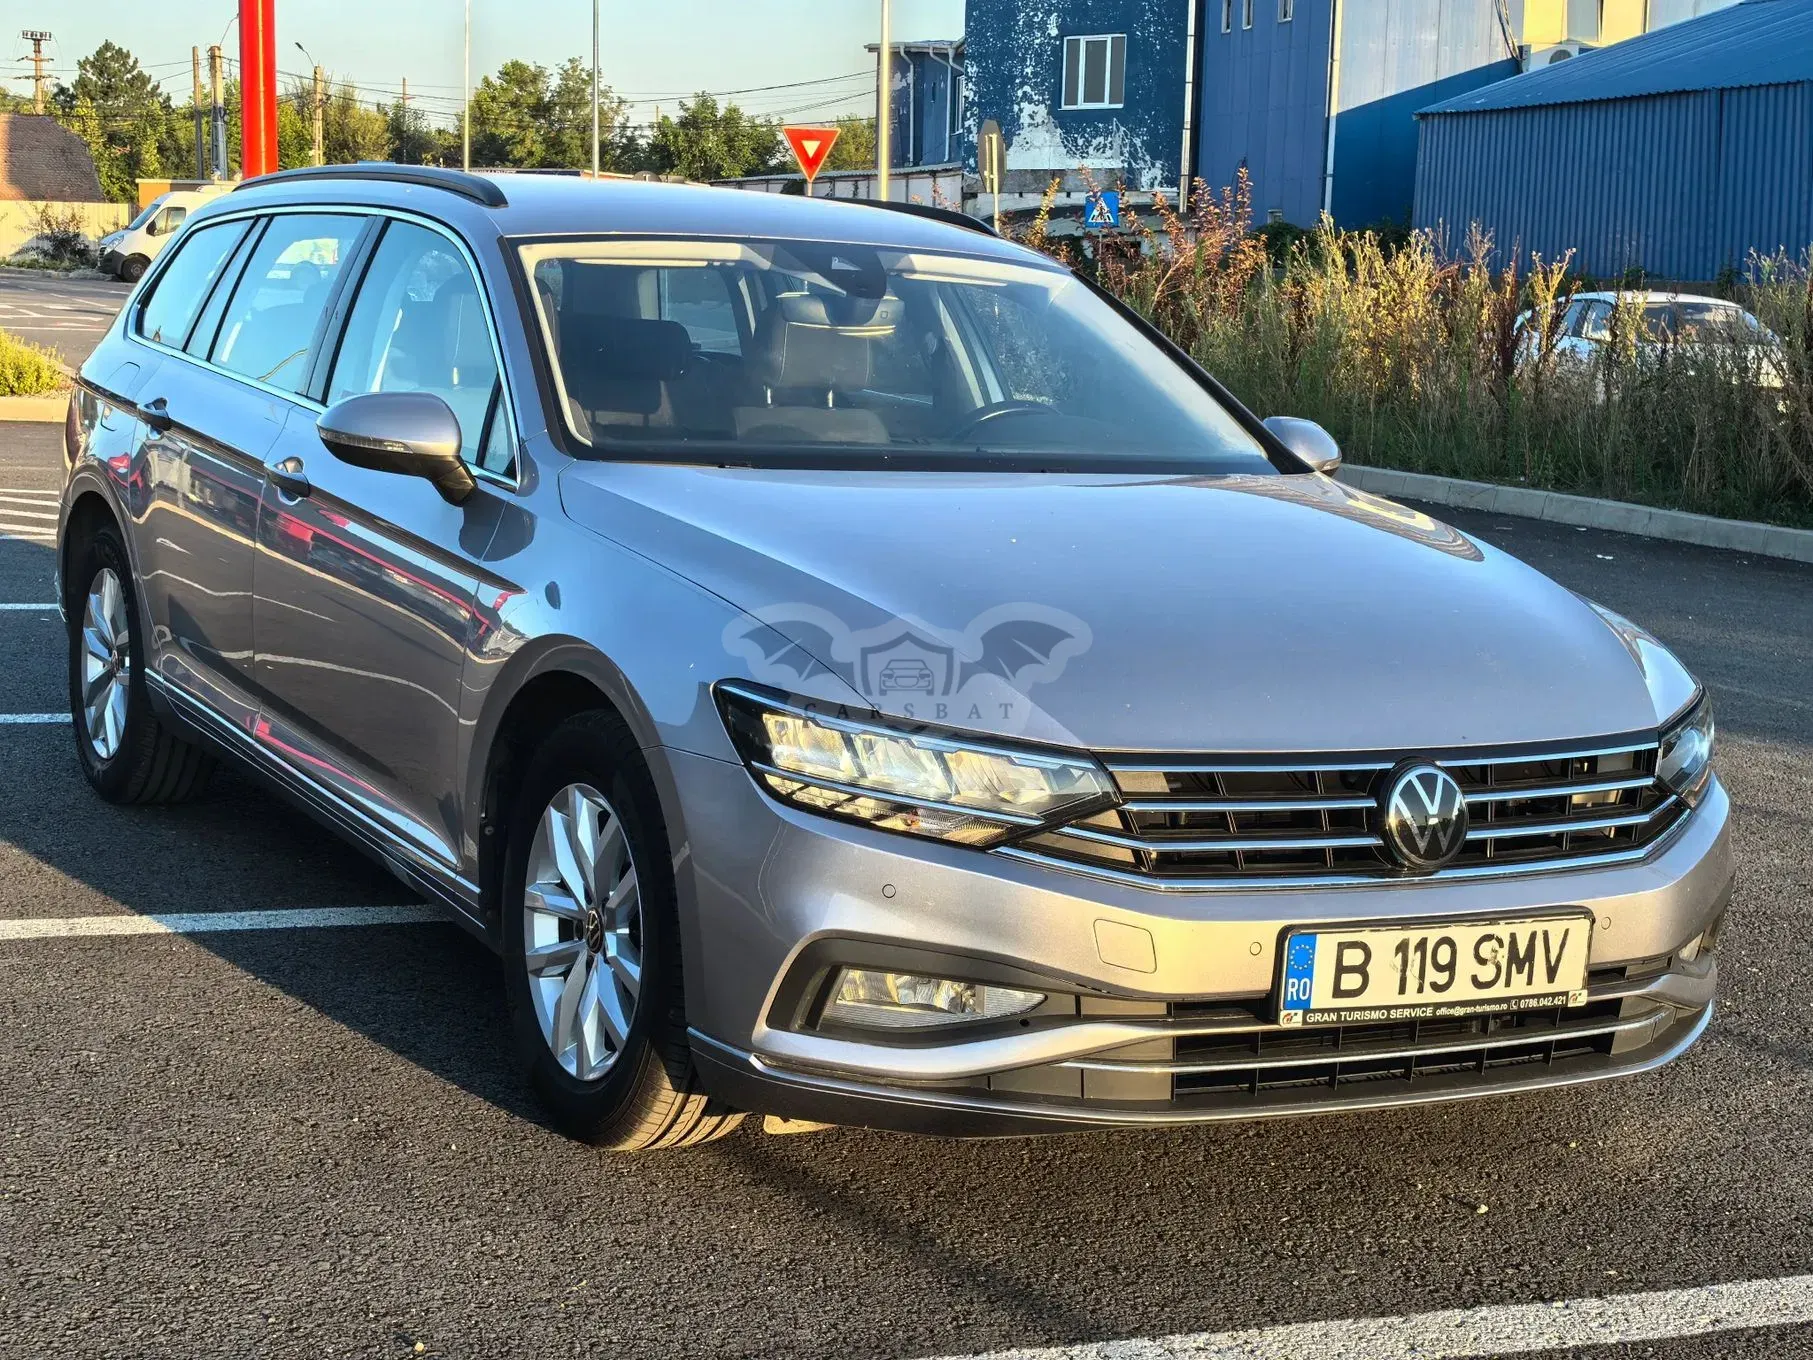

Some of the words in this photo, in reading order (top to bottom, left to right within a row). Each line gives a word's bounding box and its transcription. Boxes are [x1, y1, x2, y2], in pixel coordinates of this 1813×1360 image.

[1332, 940, 1372, 999] B
[1394, 936, 1457, 996] 119
[1470, 928, 1570, 990] SMV
[1287, 977, 1311, 1001] RO
[1306, 1012, 1338, 1023] GRAN
[1340, 1009, 1387, 1021] TURISMO
[1389, 1007, 1433, 1019] SERVICE
[1435, 1003, 1508, 1017] office@gran-turismo.ro
